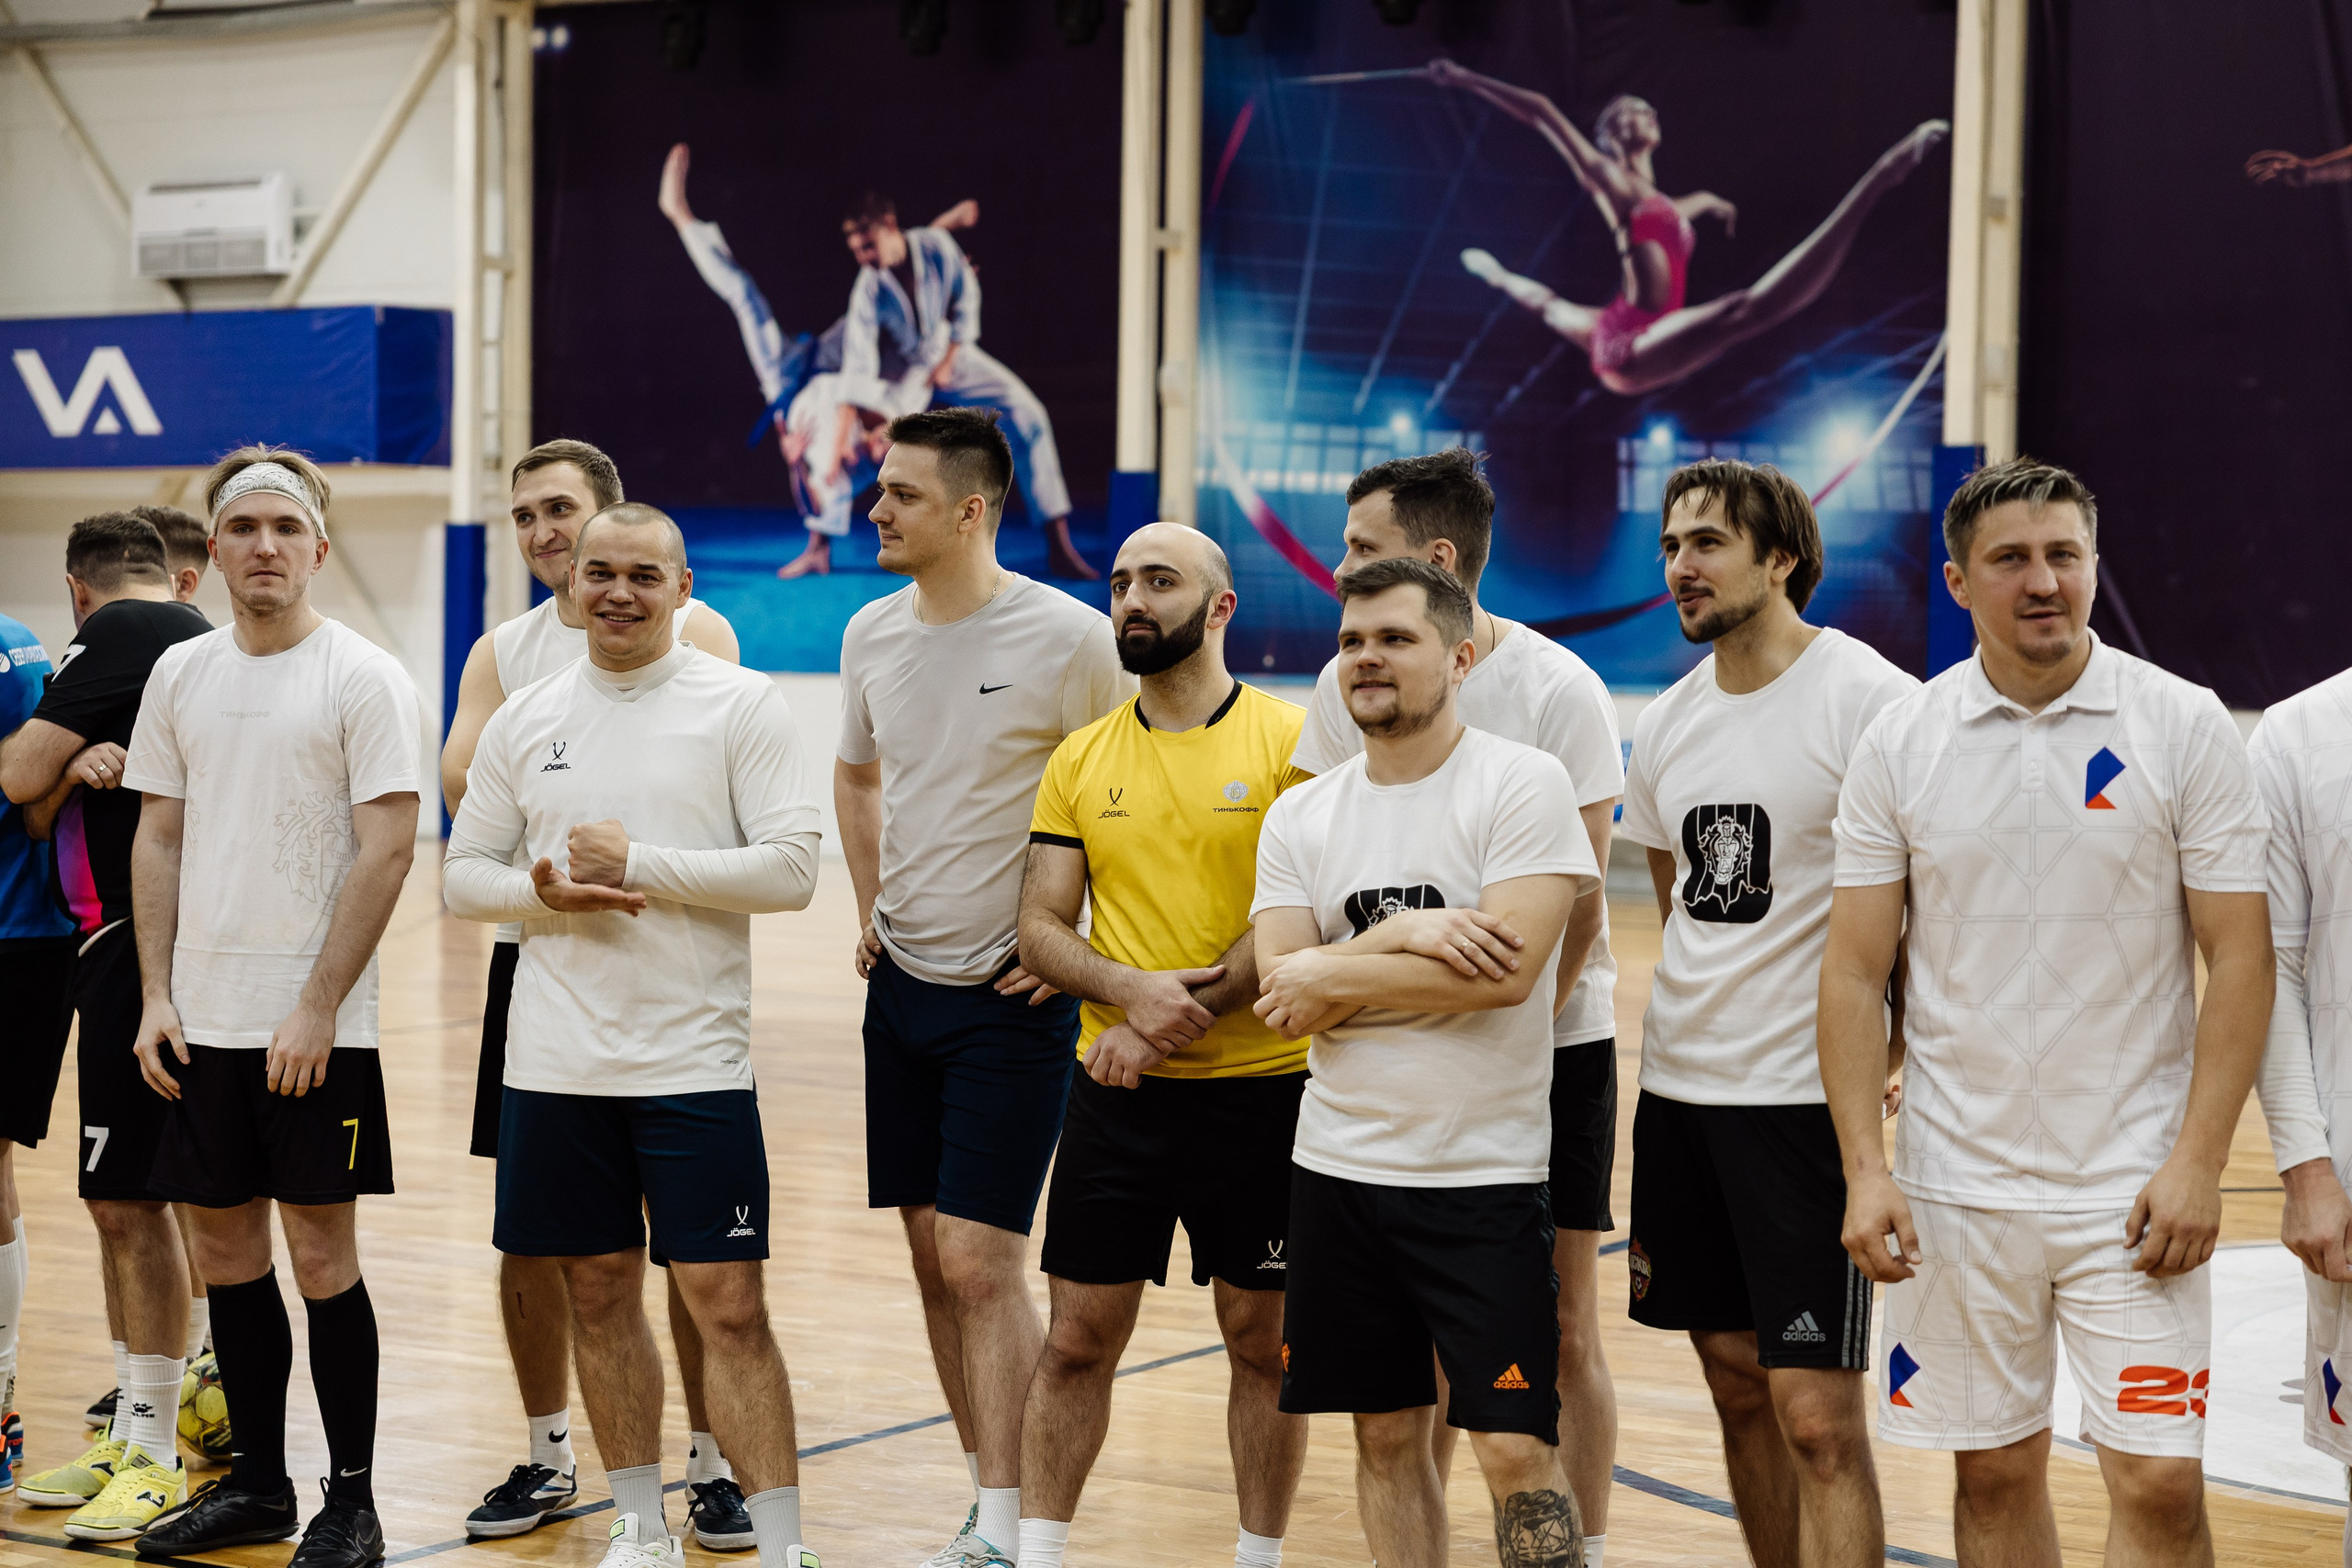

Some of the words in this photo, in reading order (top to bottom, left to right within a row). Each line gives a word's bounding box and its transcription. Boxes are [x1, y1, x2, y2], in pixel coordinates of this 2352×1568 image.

[540, 762, 571, 773] JÖGEL
[1097, 809, 1131, 819] JÖGEL
[85, 1125, 109, 1172] 7
[342, 1118, 359, 1170] 7
[726, 1227, 756, 1237] JÖGEL
[1256, 1259, 1287, 1269] JÖGE
[1782, 1329, 1826, 1342] adidas
[1493, 1380, 1530, 1389] adidas
